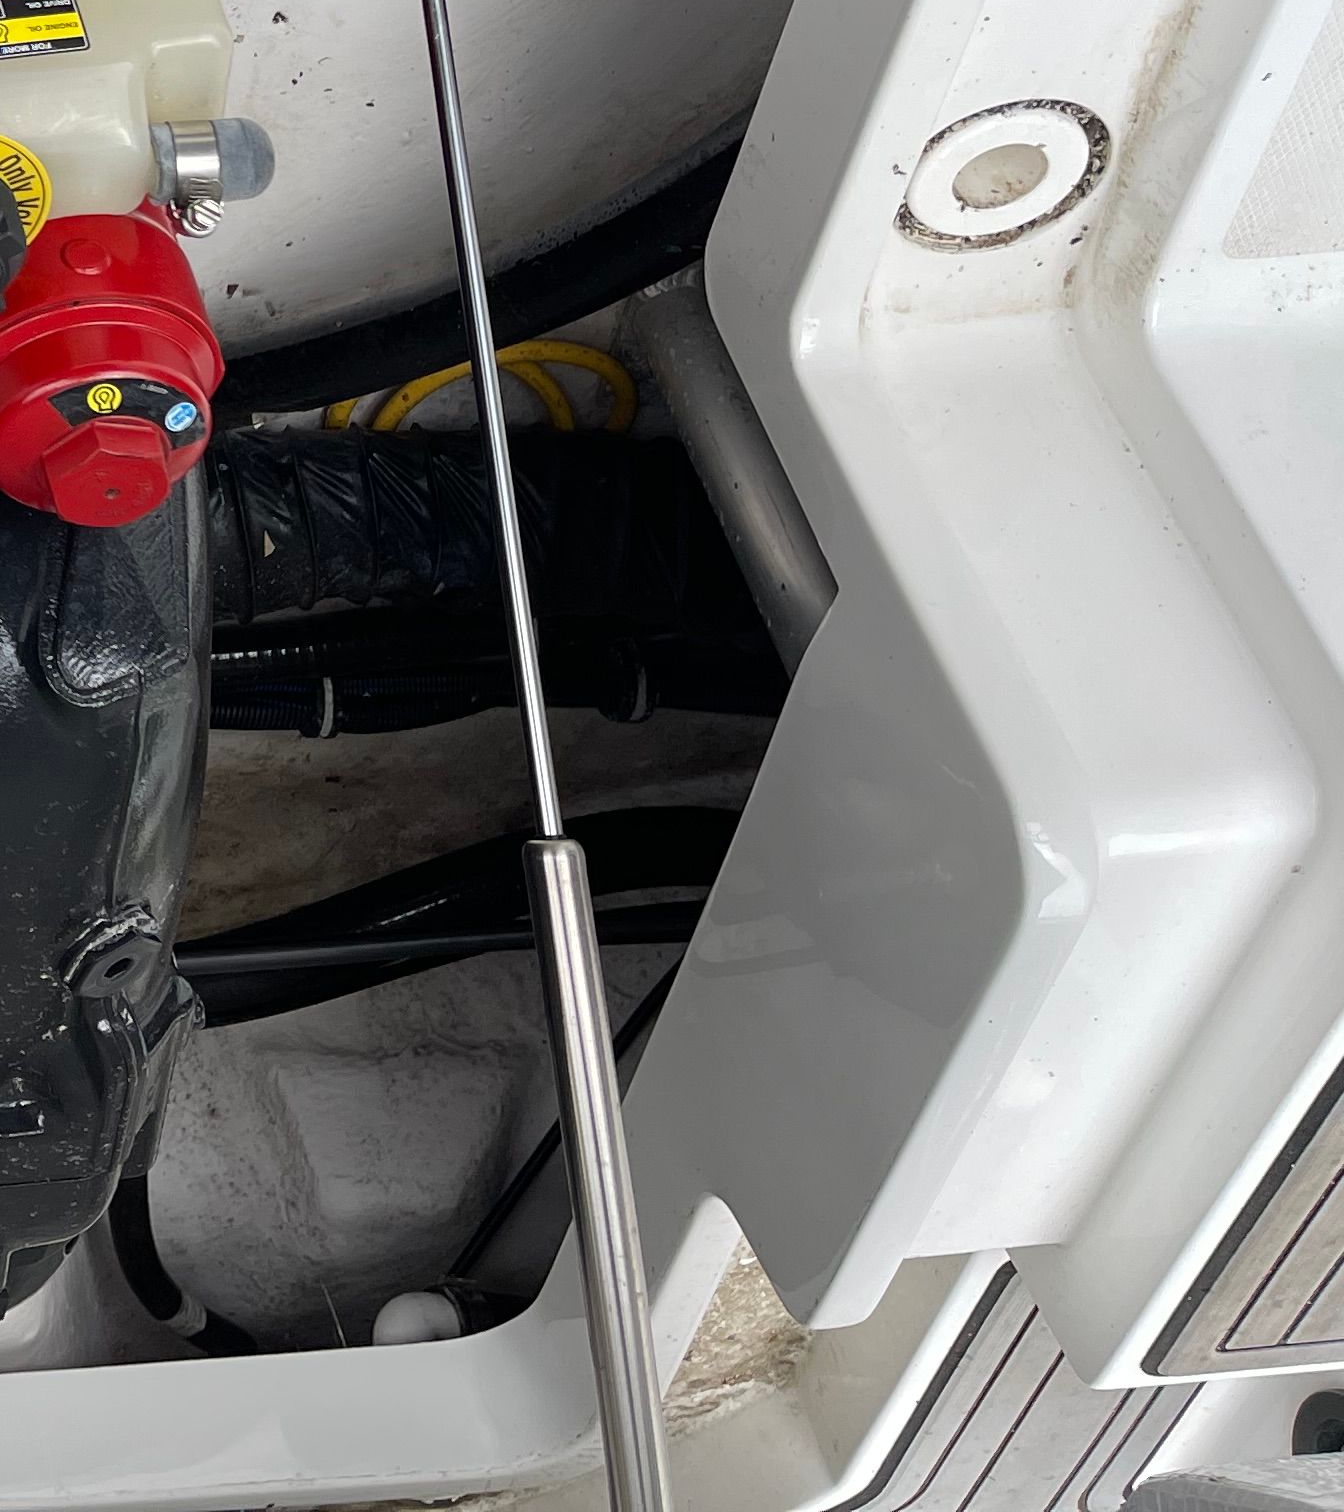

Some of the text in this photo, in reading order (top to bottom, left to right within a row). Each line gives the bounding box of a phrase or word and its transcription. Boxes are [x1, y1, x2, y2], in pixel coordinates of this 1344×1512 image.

[44, 20, 78, 30] ENGINE
[0, 44, 30, 53] MORE
[30, 42, 51, 50] FOR
